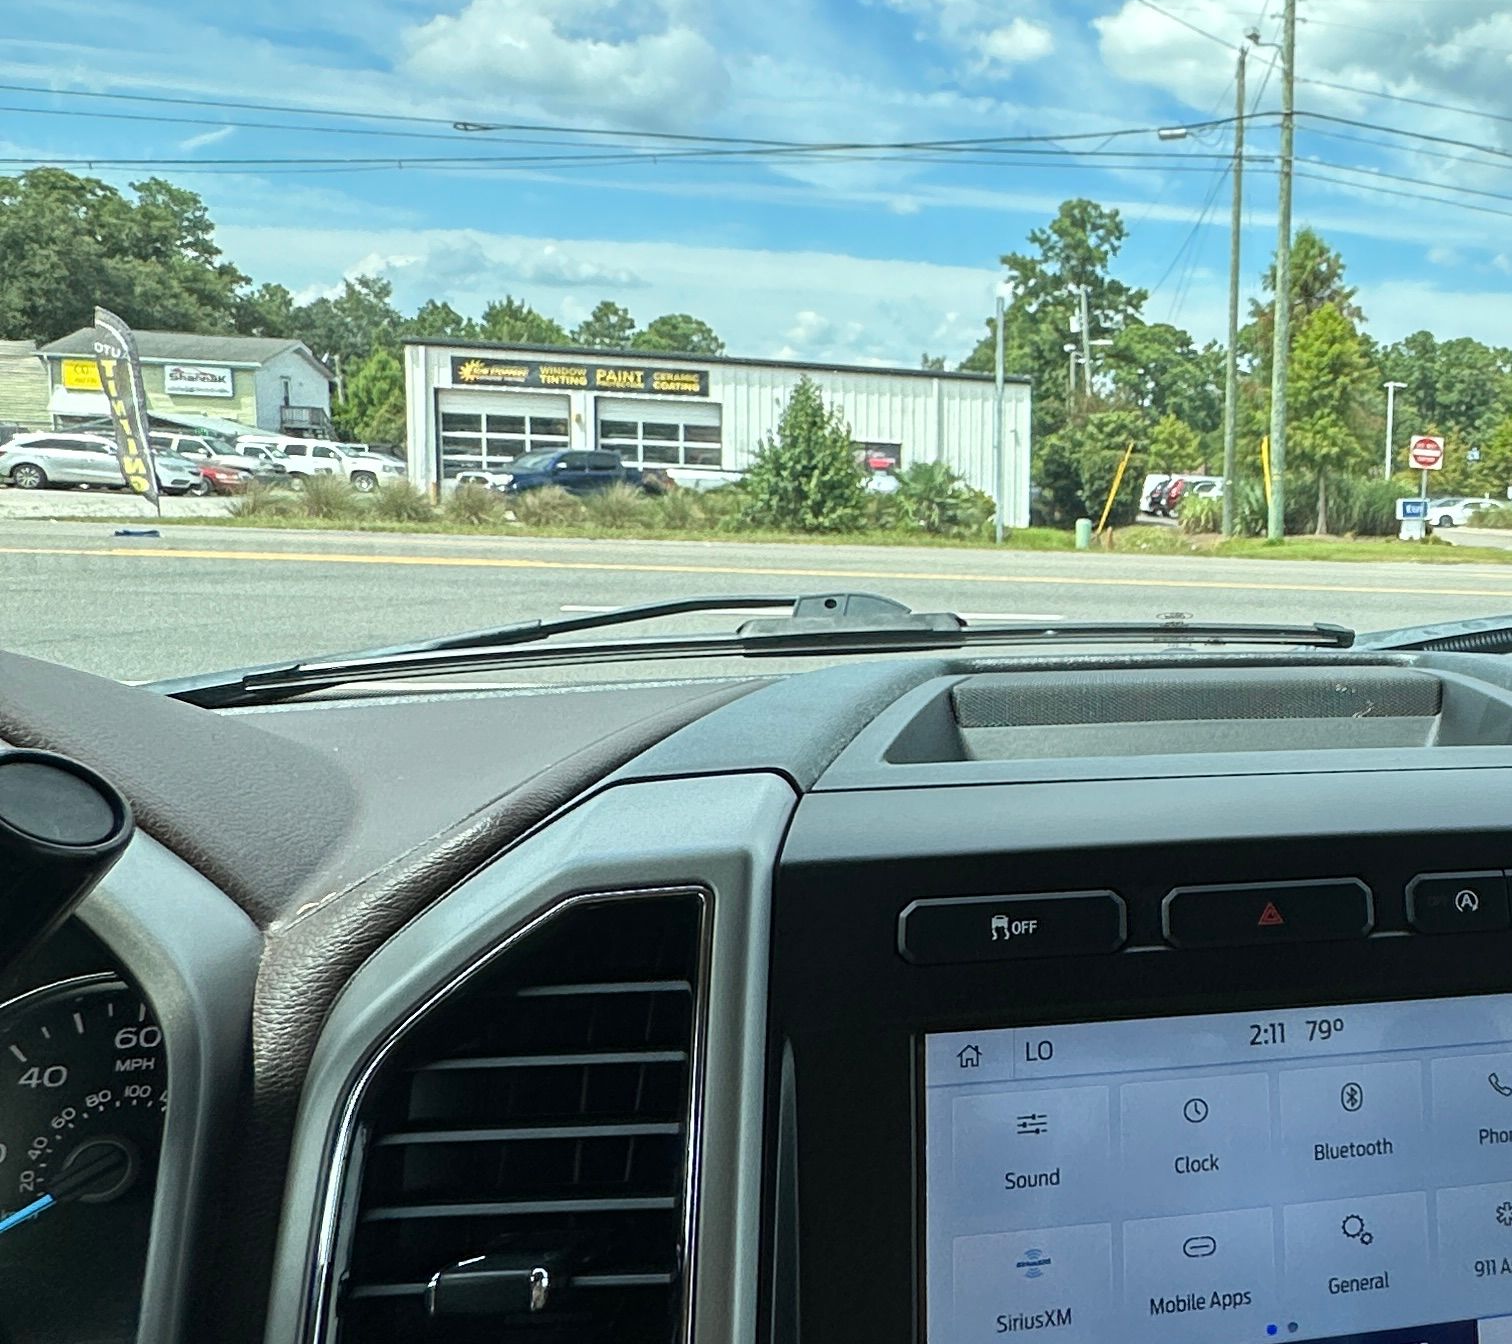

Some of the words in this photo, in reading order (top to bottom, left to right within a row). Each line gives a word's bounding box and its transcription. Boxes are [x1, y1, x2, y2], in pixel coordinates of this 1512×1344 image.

[539, 365, 588, 376] WINDOW
[539, 375, 588, 386] TINTING
[596, 368, 645, 383] PAINT
[1011, 919, 1038, 935] OFF
[114, 1026, 163, 1050] 60
[1249, 1022, 1285, 1046] 2:11
[1025, 1040, 1054, 1062] LO
[114, 1057, 156, 1072] MPH
[17, 1065, 68, 1089] 40
[85, 1089, 112, 1108] 80
[123, 1084, 152, 1098] 100
[50, 1107, 76, 1129] 60
[27, 1136, 48, 1161] 40
[1314, 1137, 1394, 1161] Bluetooth
[1174, 1153, 1220, 1175] Clock
[19, 1170, 35, 1193] 20
[1004, 1167, 1060, 1190] Sound
[1474, 1259, 1505, 1278] 911
[1328, 1270, 1390, 1295] General
[1149, 1293, 1206, 1316] Mobile
[1209, 1290, 1252, 1311] Apps
[996, 1307, 1072, 1334] SiriusXM
